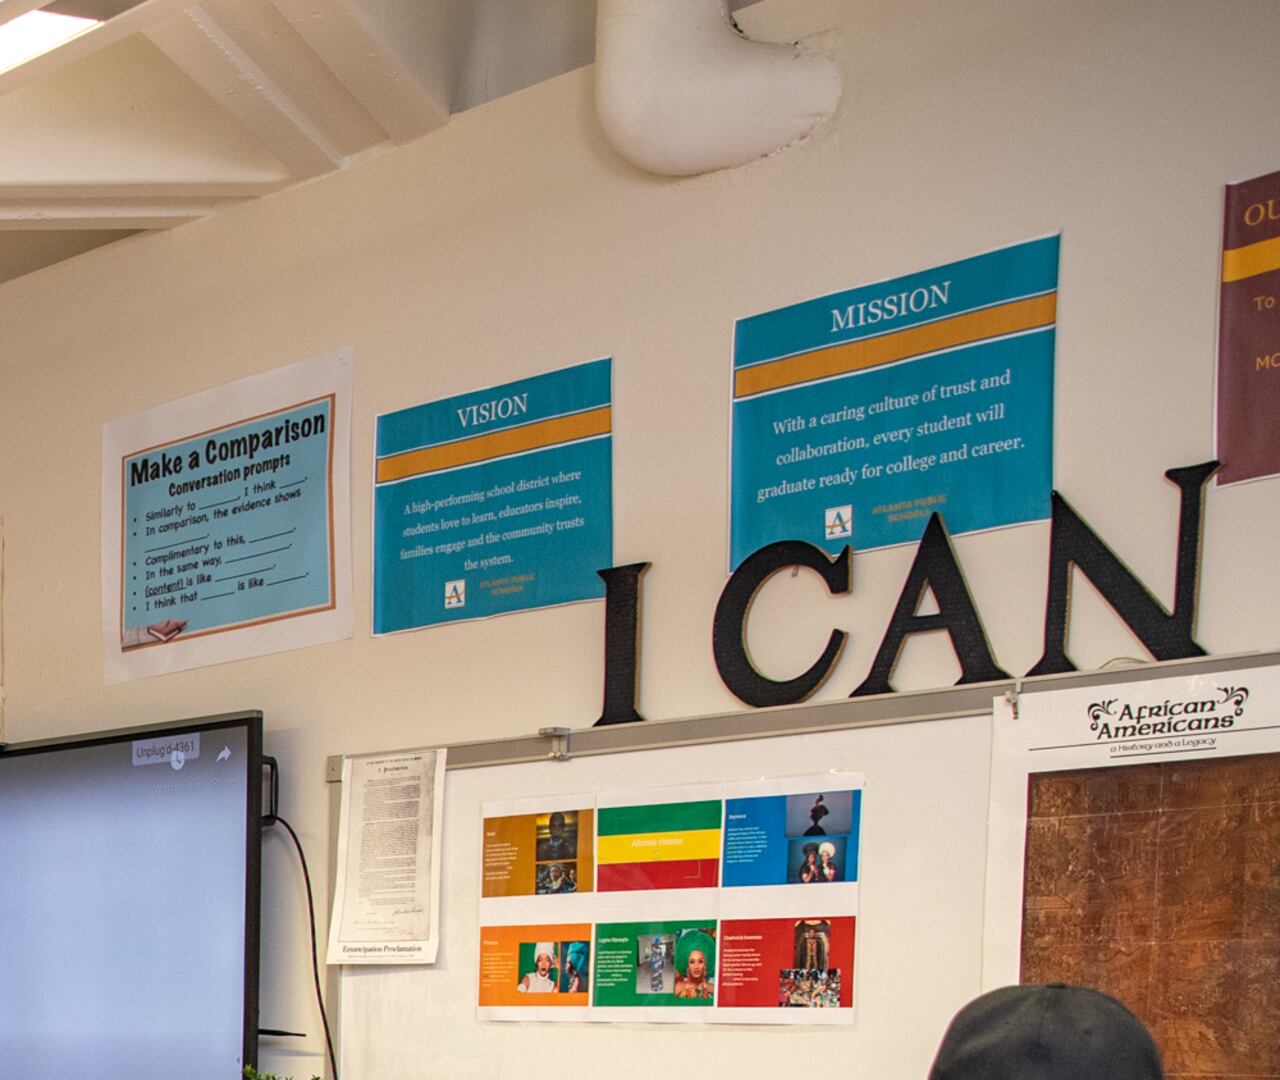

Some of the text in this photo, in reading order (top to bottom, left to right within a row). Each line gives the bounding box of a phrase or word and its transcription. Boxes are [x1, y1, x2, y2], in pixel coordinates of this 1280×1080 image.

[830, 281, 952, 333] MISSION
[1254, 297, 1275, 311] TO
[457, 393, 528, 428] VISION
[773, 369, 1011, 435] With a caring culture of trust and
[131, 413, 325, 486] Make a Comparison
[776, 403, 1005, 466] collaboration, every student will
[169, 453, 290, 497] Conversation prompts
[757, 436, 1025, 502] graduate ready for college and career.
[146, 503, 183, 522] Similarly
[187, 500, 196, 510] to
[253, 480, 276, 494] think
[146, 489, 301, 536] In comparison, the evidence shows
[404, 469, 581, 515] A high-performing school district where
[402, 494, 582, 537] students love to learn, educators inspire,
[146, 541, 209, 566] Complimentary
[214, 540, 223, 549] to
[400, 517, 584, 560] families engage and the community trusts
[146, 571, 155, 580] In
[159, 566, 173, 577] the
[177, 562, 199, 573] same
[187, 577, 193, 586] is
[197, 573, 212, 584] like
[464, 554, 514, 570] the system.
[145, 577, 264, 611] I think that is like
[594, 459, 1221, 727] I CAN
